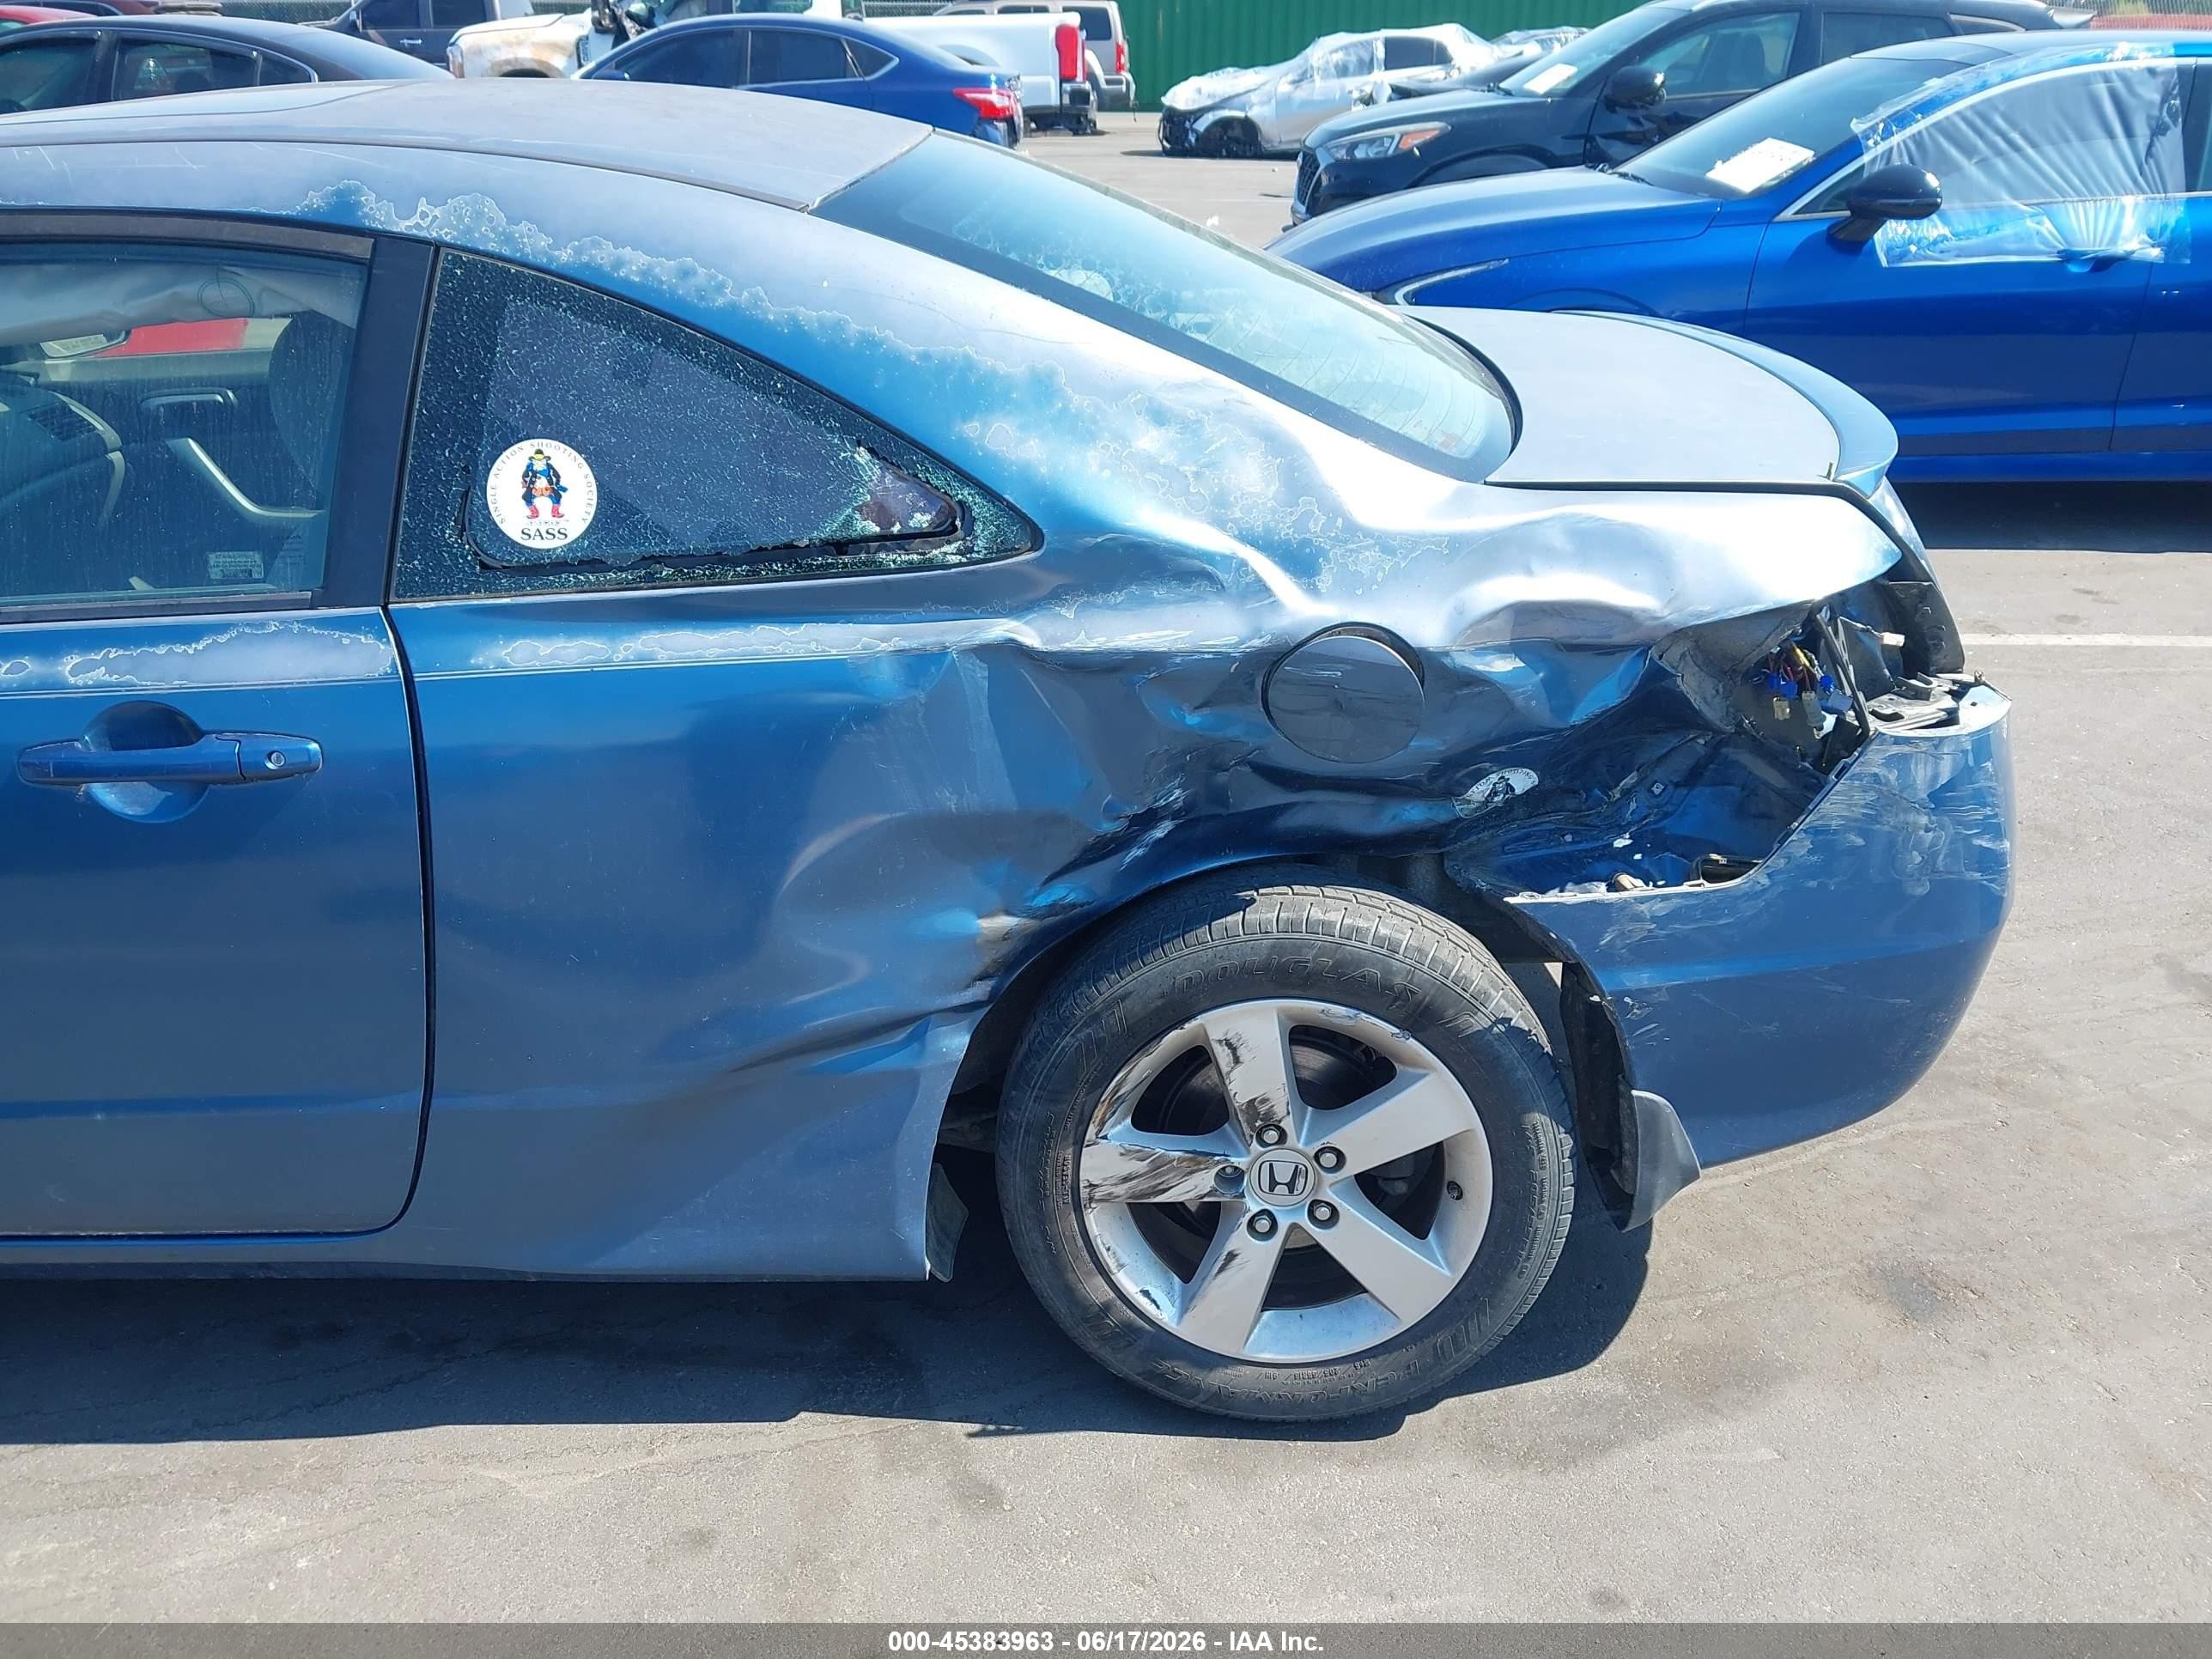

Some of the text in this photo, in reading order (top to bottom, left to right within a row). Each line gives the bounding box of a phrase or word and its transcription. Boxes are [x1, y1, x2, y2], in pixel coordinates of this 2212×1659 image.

[489, 441, 594, 525] SINGLE ACTION SHOOTING SOCIETY
[520, 527, 568, 541] SASS
[1174, 955, 1422, 1010] DOUGLAS
